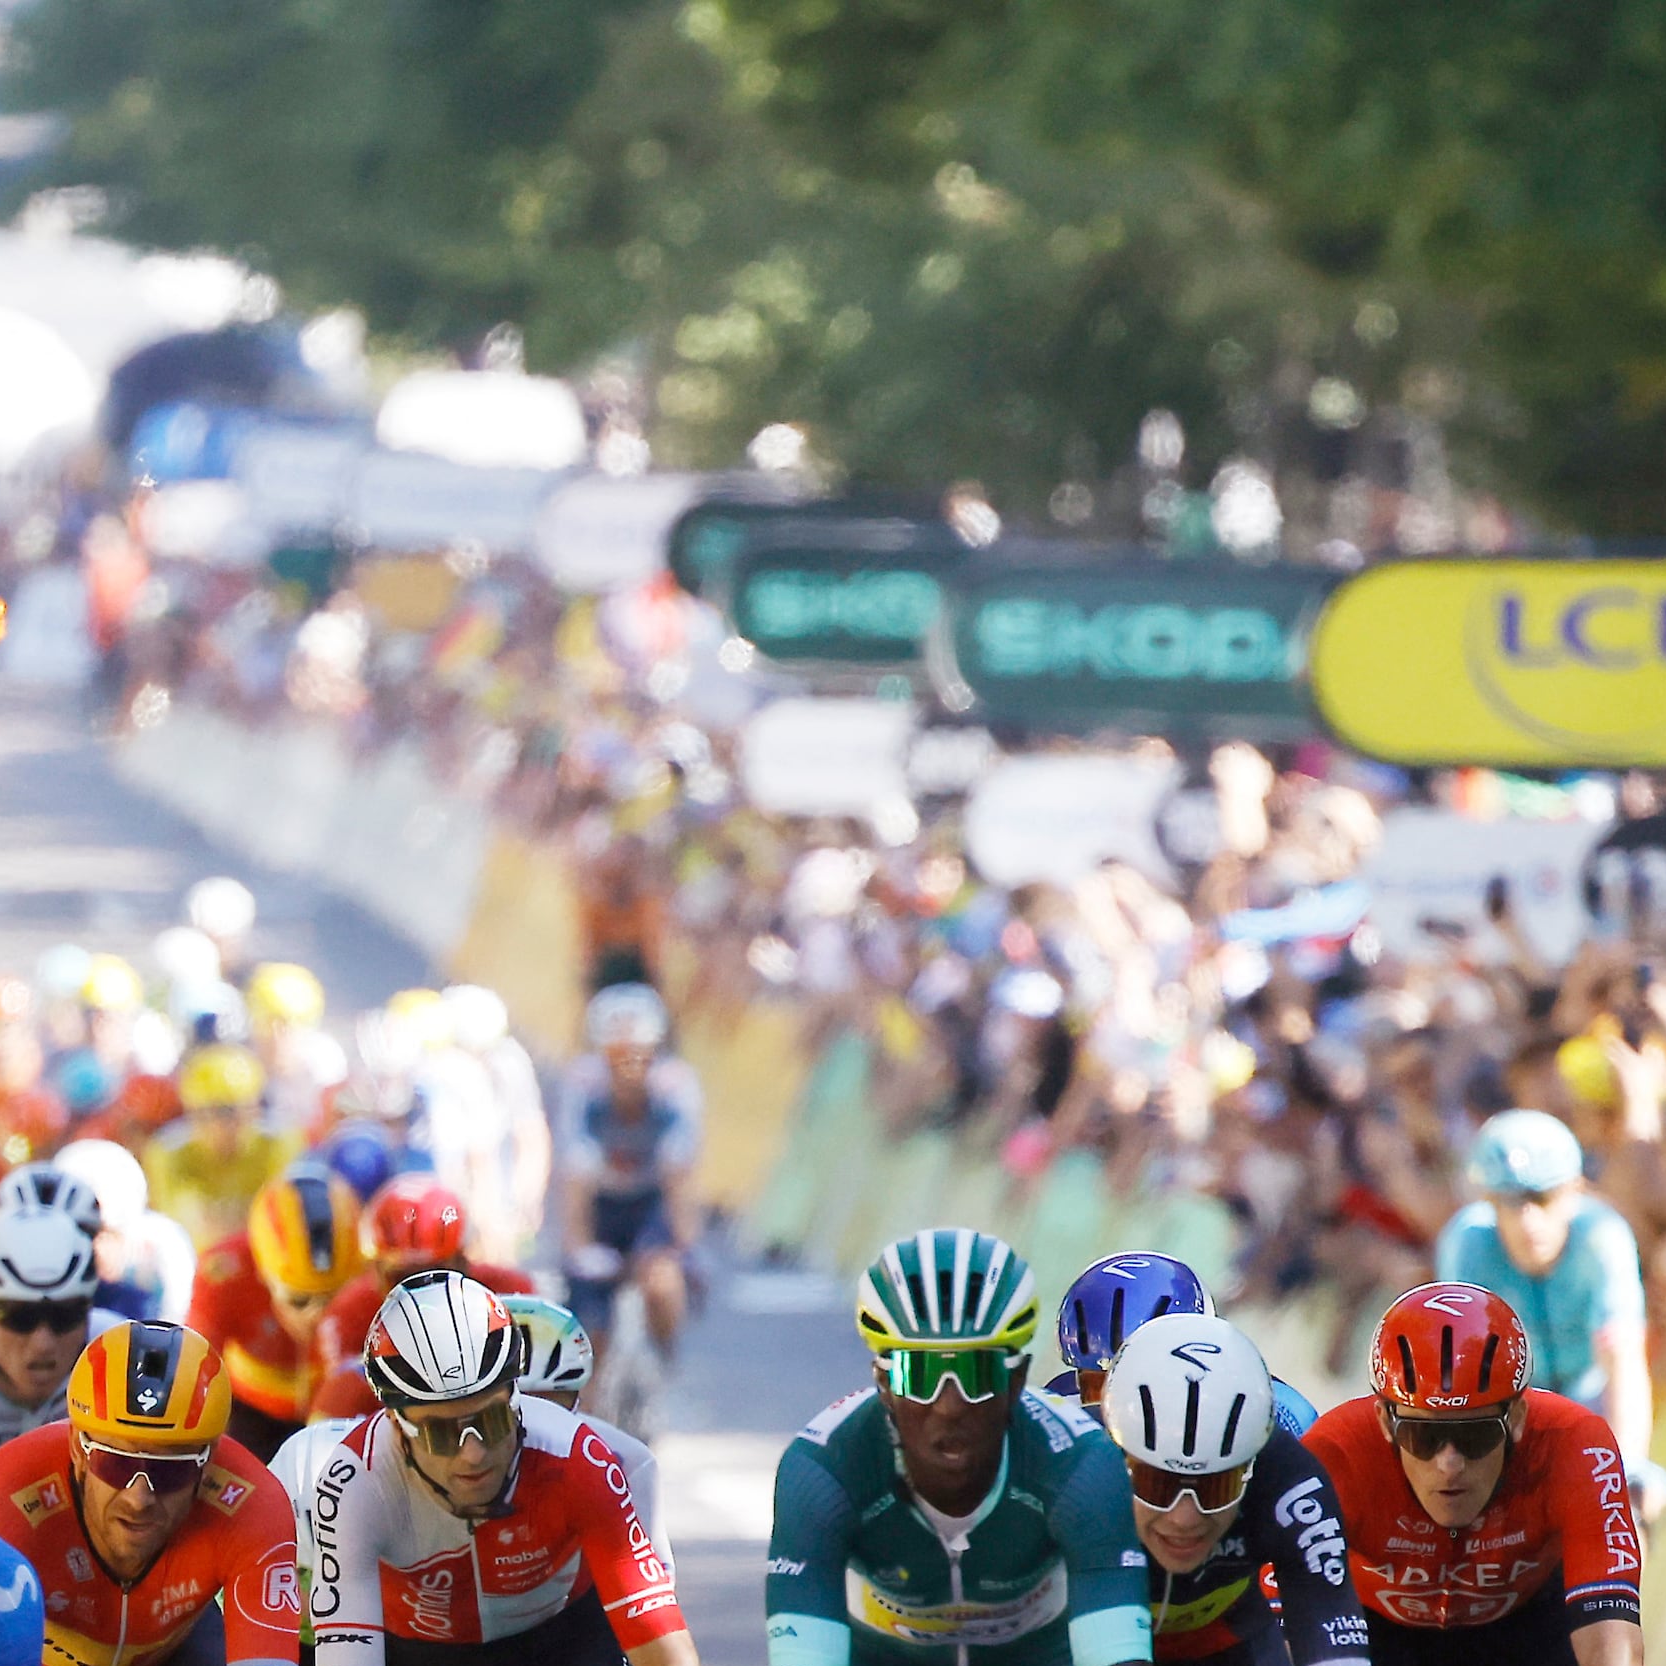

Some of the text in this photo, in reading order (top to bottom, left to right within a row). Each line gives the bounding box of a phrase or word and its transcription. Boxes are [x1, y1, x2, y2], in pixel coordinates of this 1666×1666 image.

[311, 1458, 357, 1618] Cofidis
[1275, 1475, 1347, 1588] lotto
[1582, 1446, 1639, 1575] ARKEA
